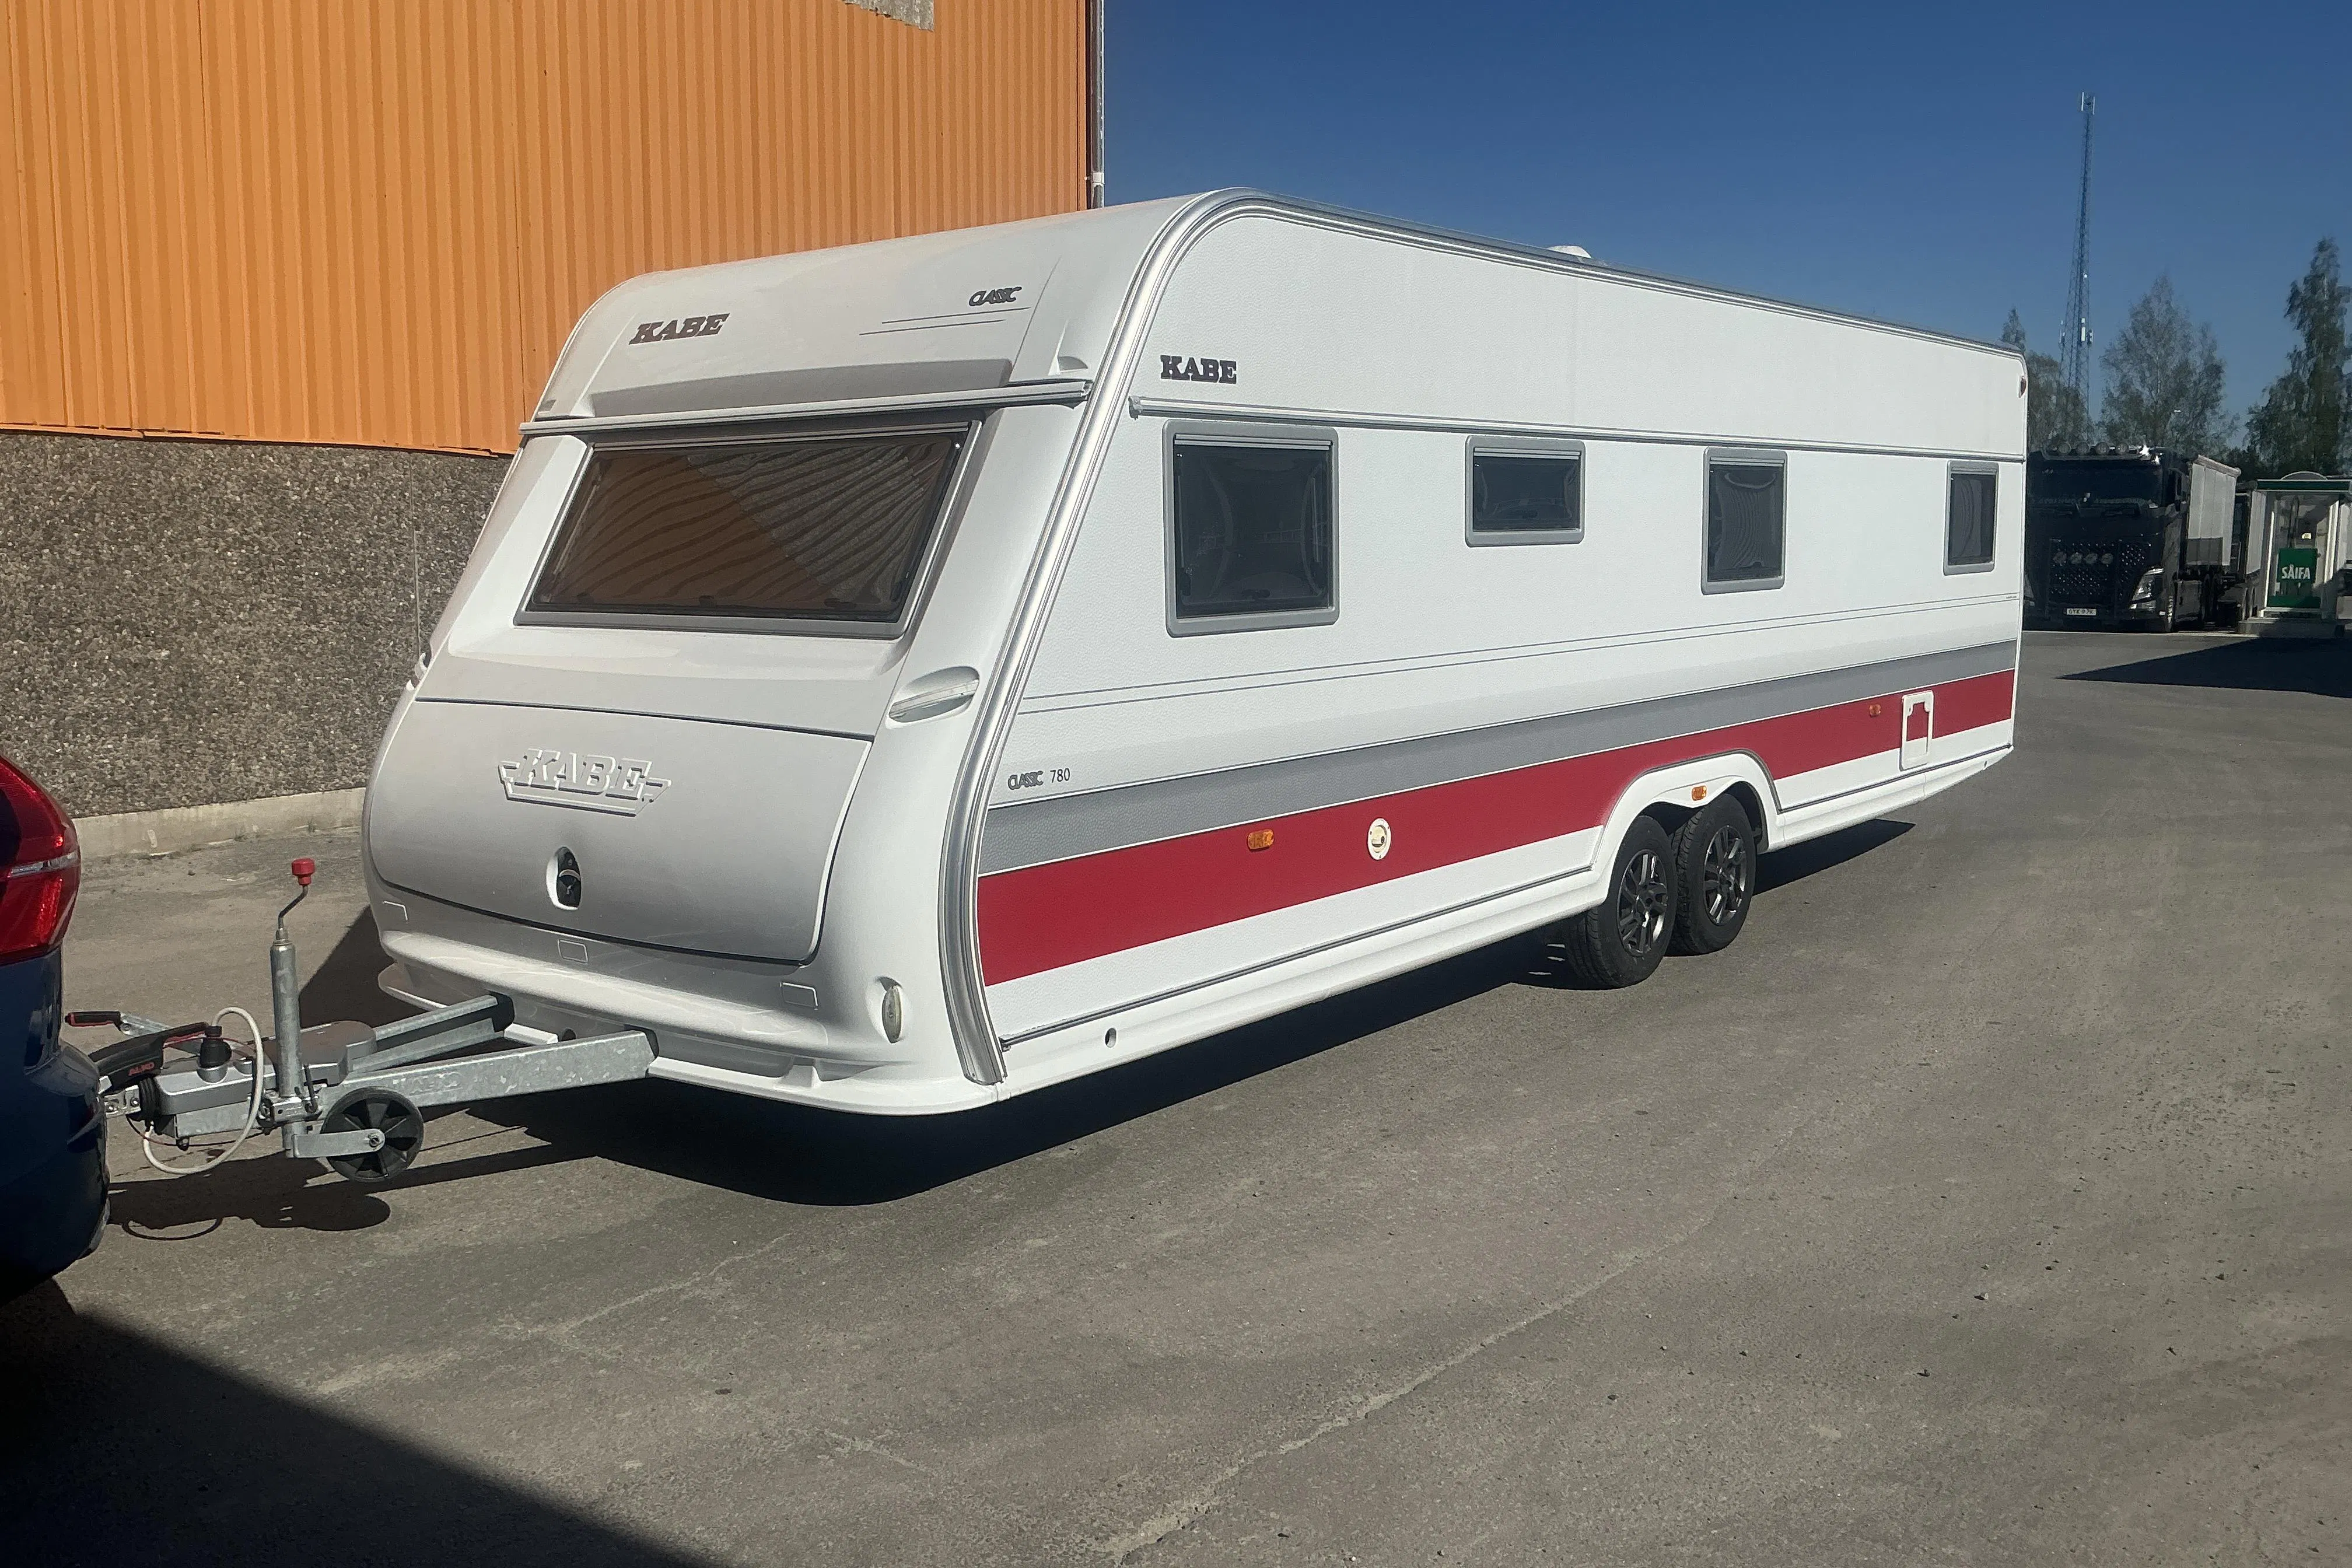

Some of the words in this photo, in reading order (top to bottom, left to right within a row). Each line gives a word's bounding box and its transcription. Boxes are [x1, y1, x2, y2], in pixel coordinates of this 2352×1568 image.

[629, 313, 730, 344] KABE
[1160, 354, 1237, 384] KABE
[2281, 565, 2311, 579] SÅIFA
[517, 748, 653, 800] KABE
[1050, 768, 1070, 783] 780
